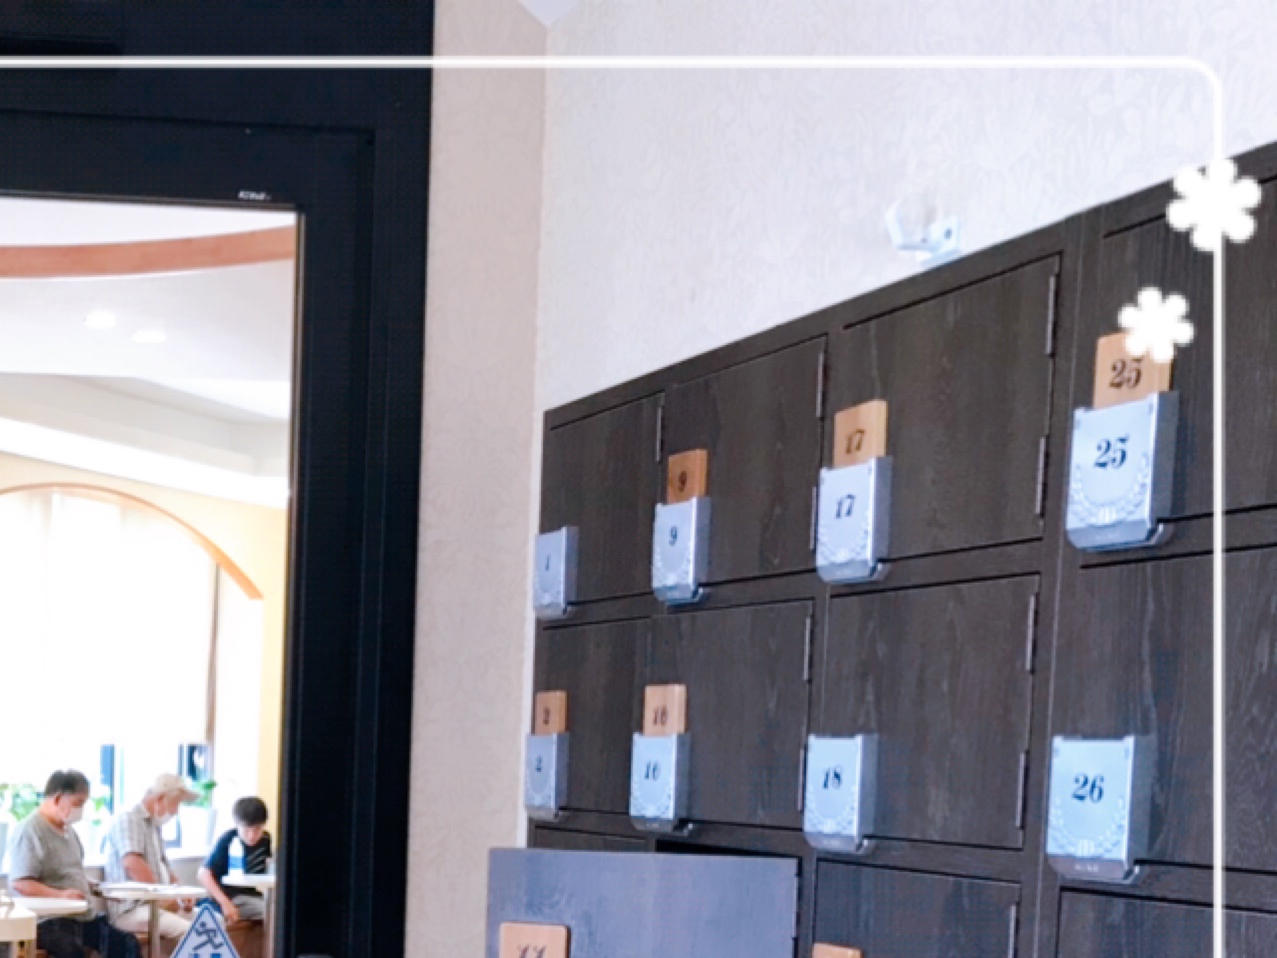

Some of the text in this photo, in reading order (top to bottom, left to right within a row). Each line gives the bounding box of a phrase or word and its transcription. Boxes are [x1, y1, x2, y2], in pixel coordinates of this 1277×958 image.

[1107, 355, 1145, 389] 25
[844, 427, 866, 455] 17
[1093, 432, 1130, 469] 25
[678, 470, 688, 493] 9
[834, 493, 857, 520] 17
[667, 525, 679, 548] 9
[822, 766, 842, 790] 18
[1071, 773, 1105, 803] 26
